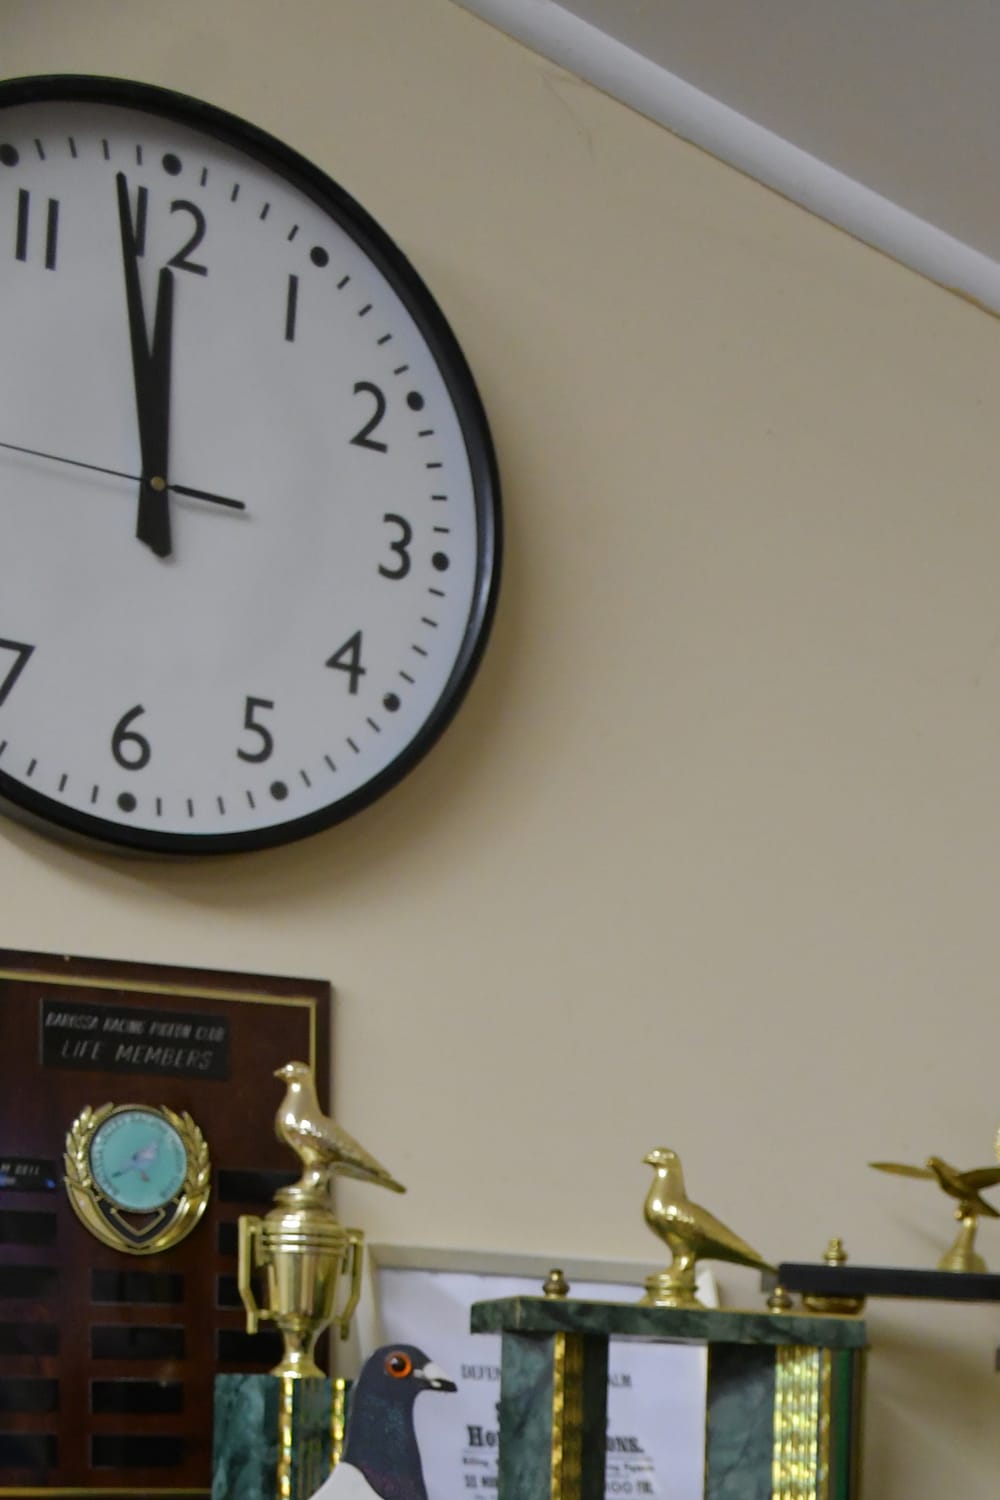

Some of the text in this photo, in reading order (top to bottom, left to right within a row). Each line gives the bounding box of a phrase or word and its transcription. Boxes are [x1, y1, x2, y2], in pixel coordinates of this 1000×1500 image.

[16, 188, 59, 271] 11
[134, 185, 208, 277] 12
[285, 274, 299, 342] 1
[349, 382, 389, 453] 2
[377, 513, 412, 580] 3
[325, 630, 367, 694] 4
[111, 704, 151, 771] 6
[236, 696, 276, 763] 5
[61, 1039, 213, 1070] LIFE MEMBERS
